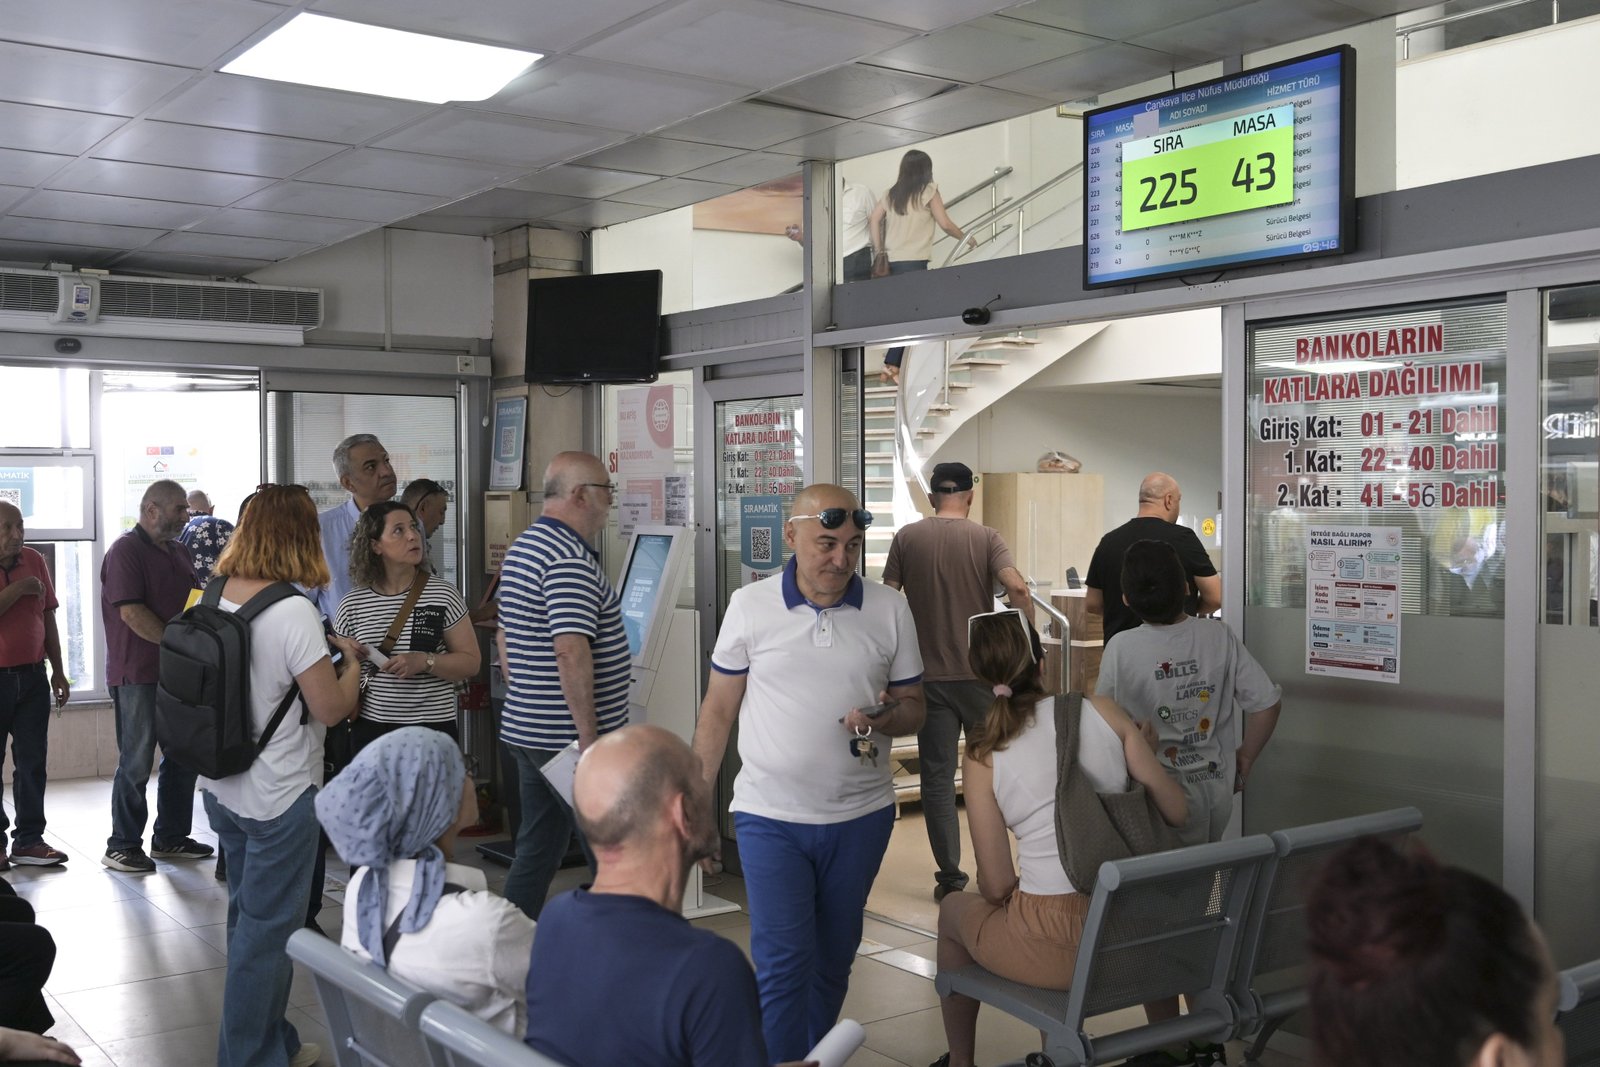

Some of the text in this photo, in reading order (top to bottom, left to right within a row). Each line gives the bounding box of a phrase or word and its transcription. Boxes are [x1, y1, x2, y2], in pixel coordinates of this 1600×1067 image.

[1145, 96, 1179, 112] Çankaya
[1198, 86, 1221, 100] Nüfus
[1224, 73, 1269, 92] Müdürlüğü
[1091, 74, 1320, 139] SIRA MASA ADI SOYADI HİZMET TÜRÜ
[1154, 113, 1276, 154] SIRA MASA
[1140, 152, 1276, 213] 225 43
[1266, 215, 1288, 226] Sürücü
[1288, 211, 1312, 223] Belgesi
[1266, 231, 1288, 242] Sürücü
[1288, 227, 1312, 239] Belgesi
[1295, 324, 1444, 365] BANKOLARIN
[1264, 361, 1482, 405] KATLARA DAĞILIMI
[735, 412, 781, 427] BANKOLARIN
[1260, 417, 1299, 445] Giriş
[1306, 416, 1342, 439] Kat:
[1360, 412, 1384, 437] 01
[1408, 409, 1432, 434] 21
[1442, 405, 1497, 434] Dahil
[725, 429, 792, 445] KATLARA DAĞILIMI
[723, 451, 736, 465] Giriş
[737, 451, 749, 462] Kat:
[754, 450, 762, 461] 01
[769, 450, 776, 461] 21
[778, 449, 795, 461] Dahil
[1284, 450, 1300, 473] 1.
[1306, 450, 1342, 473] Kat:
[1360, 447, 1386, 472] 22
[1408, 445, 1435, 470] 40
[1442, 443, 1497, 470] Dahil
[730, 468, 736, 479] 1.
[737, 467, 749, 478] Kat:
[754, 467, 762, 478] 22
[769, 467, 776, 477] 40
[778, 466, 795, 477] Dahil
[728, 483, 735, 494] 2.
[754, 483, 762, 494] 41
[769, 481, 777, 494] 56
[778, 482, 795, 494] Dahil
[1277, 483, 1294, 507] 2.
[1360, 483, 1384, 507] 41
[1408, 482, 1435, 508] 56
[1442, 481, 1497, 507] Dahil
[743, 502, 779, 514] SIRAMATİK
[1331, 530, 1350, 538] BAĞLI
[1310, 538, 1373, 547] NASIL ALIRIM?
[1154, 664, 1199, 681] BULLS
